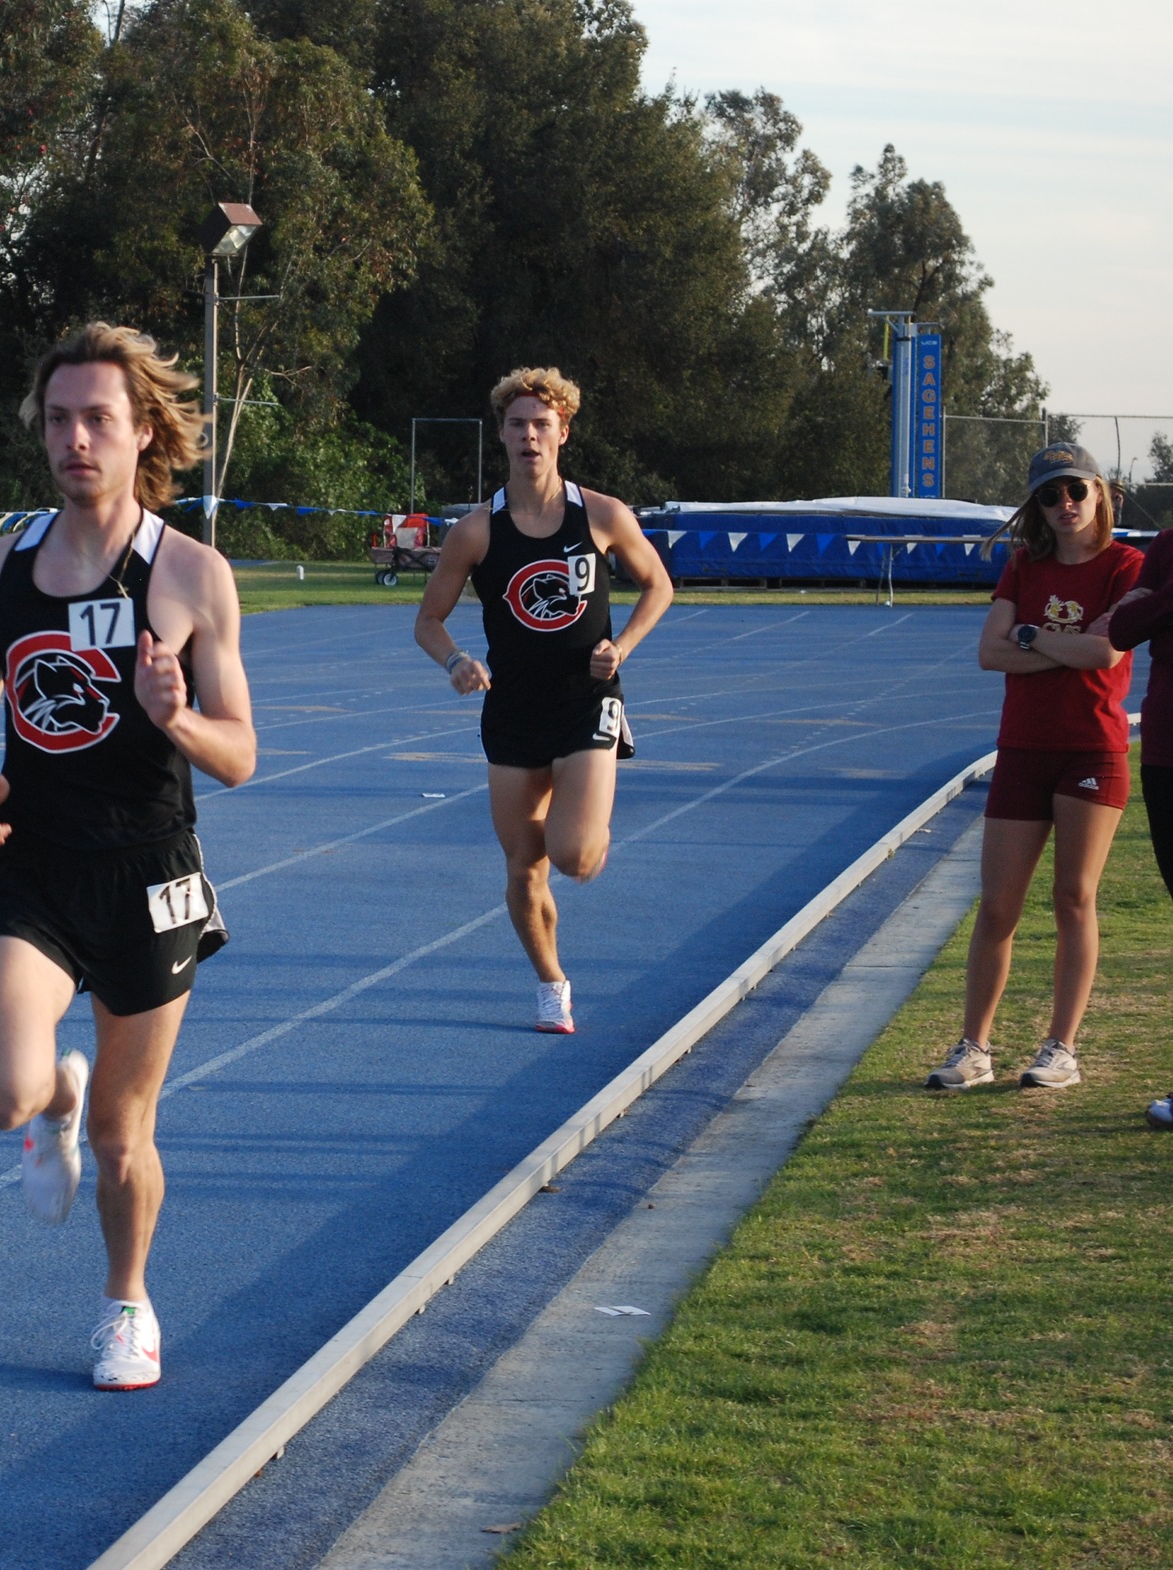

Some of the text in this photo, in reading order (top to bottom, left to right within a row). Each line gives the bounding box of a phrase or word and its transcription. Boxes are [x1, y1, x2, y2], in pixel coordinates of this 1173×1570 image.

[922, 355, 936, 487] SAGEHENS
[574, 557, 591, 592] 9
[79, 602, 121, 646] 17
[606, 700, 621, 732] 9
[159, 878, 191, 924] 17
